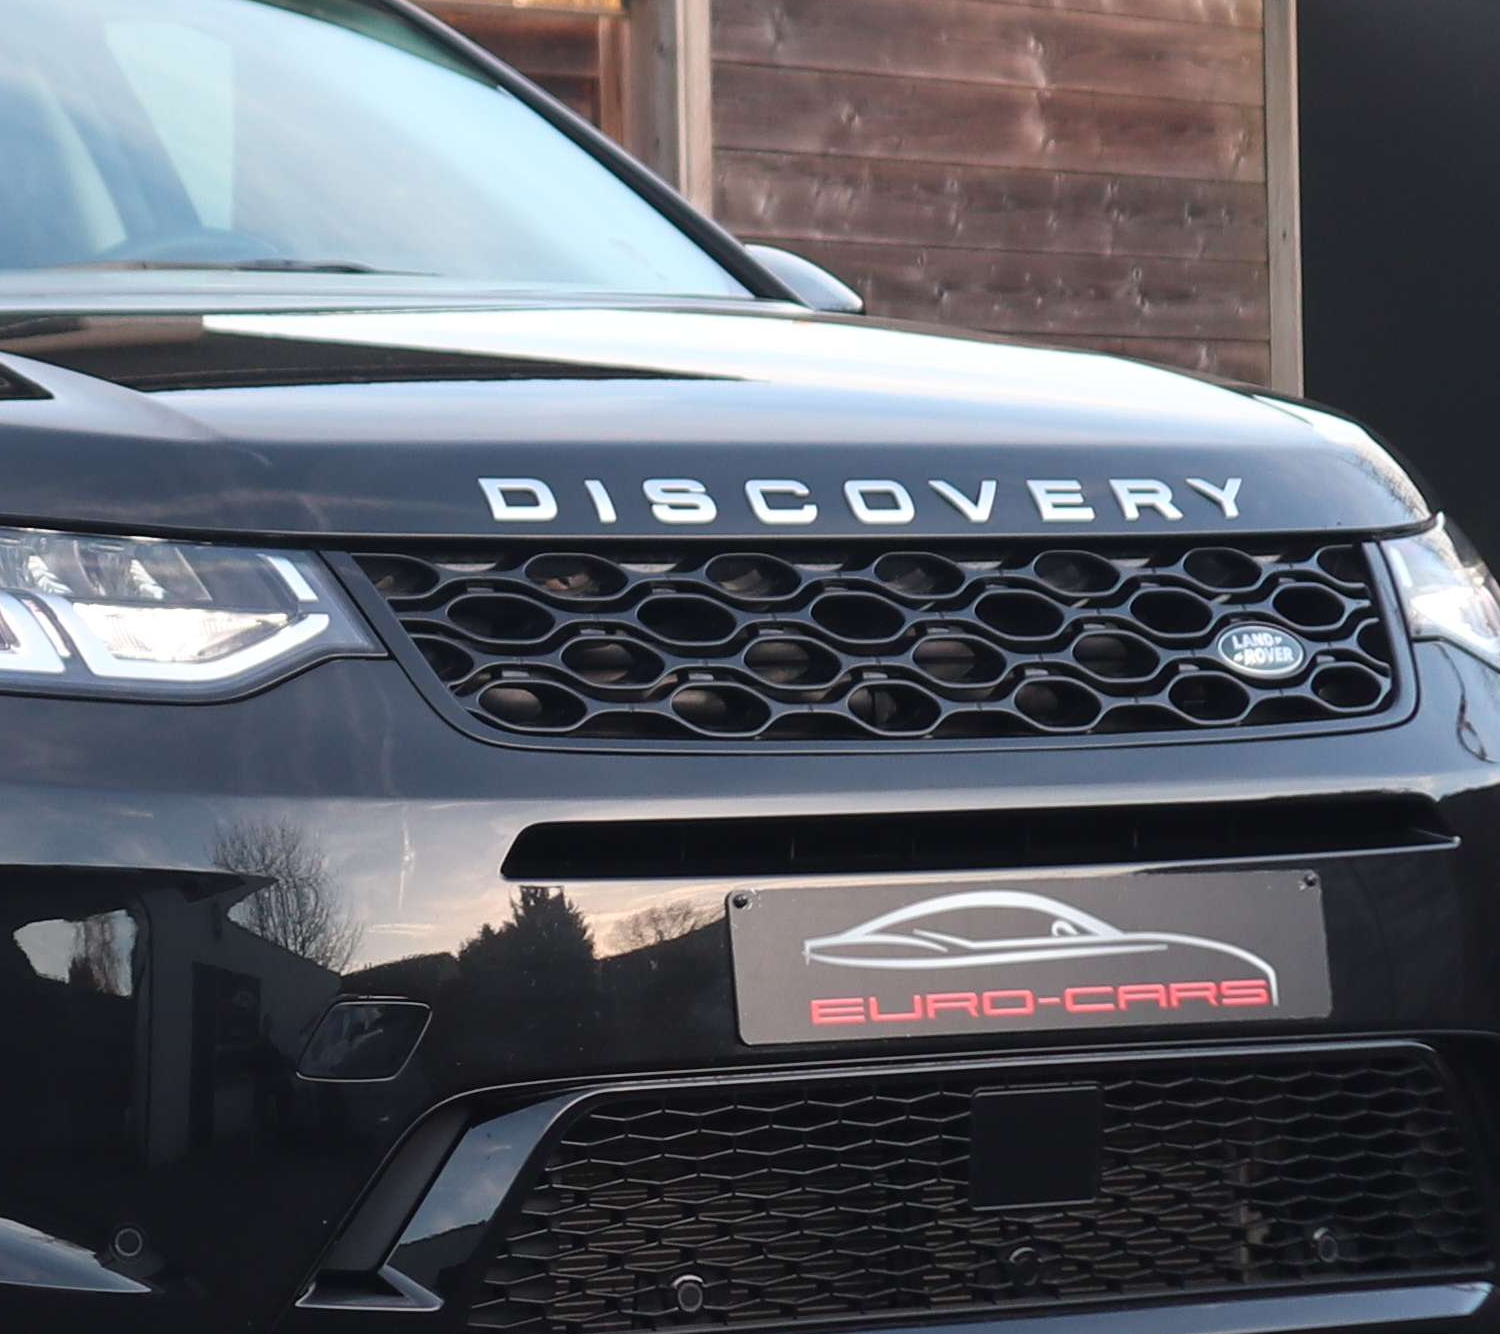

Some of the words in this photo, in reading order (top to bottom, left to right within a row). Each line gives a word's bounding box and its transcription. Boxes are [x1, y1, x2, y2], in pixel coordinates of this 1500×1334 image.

[477, 477, 1244, 525] DISCOVERY
[1232, 633, 1274, 650] LAND
[1243, 647, 1294, 665] ROVER
[809, 979, 1270, 1026] EURO-CARS
